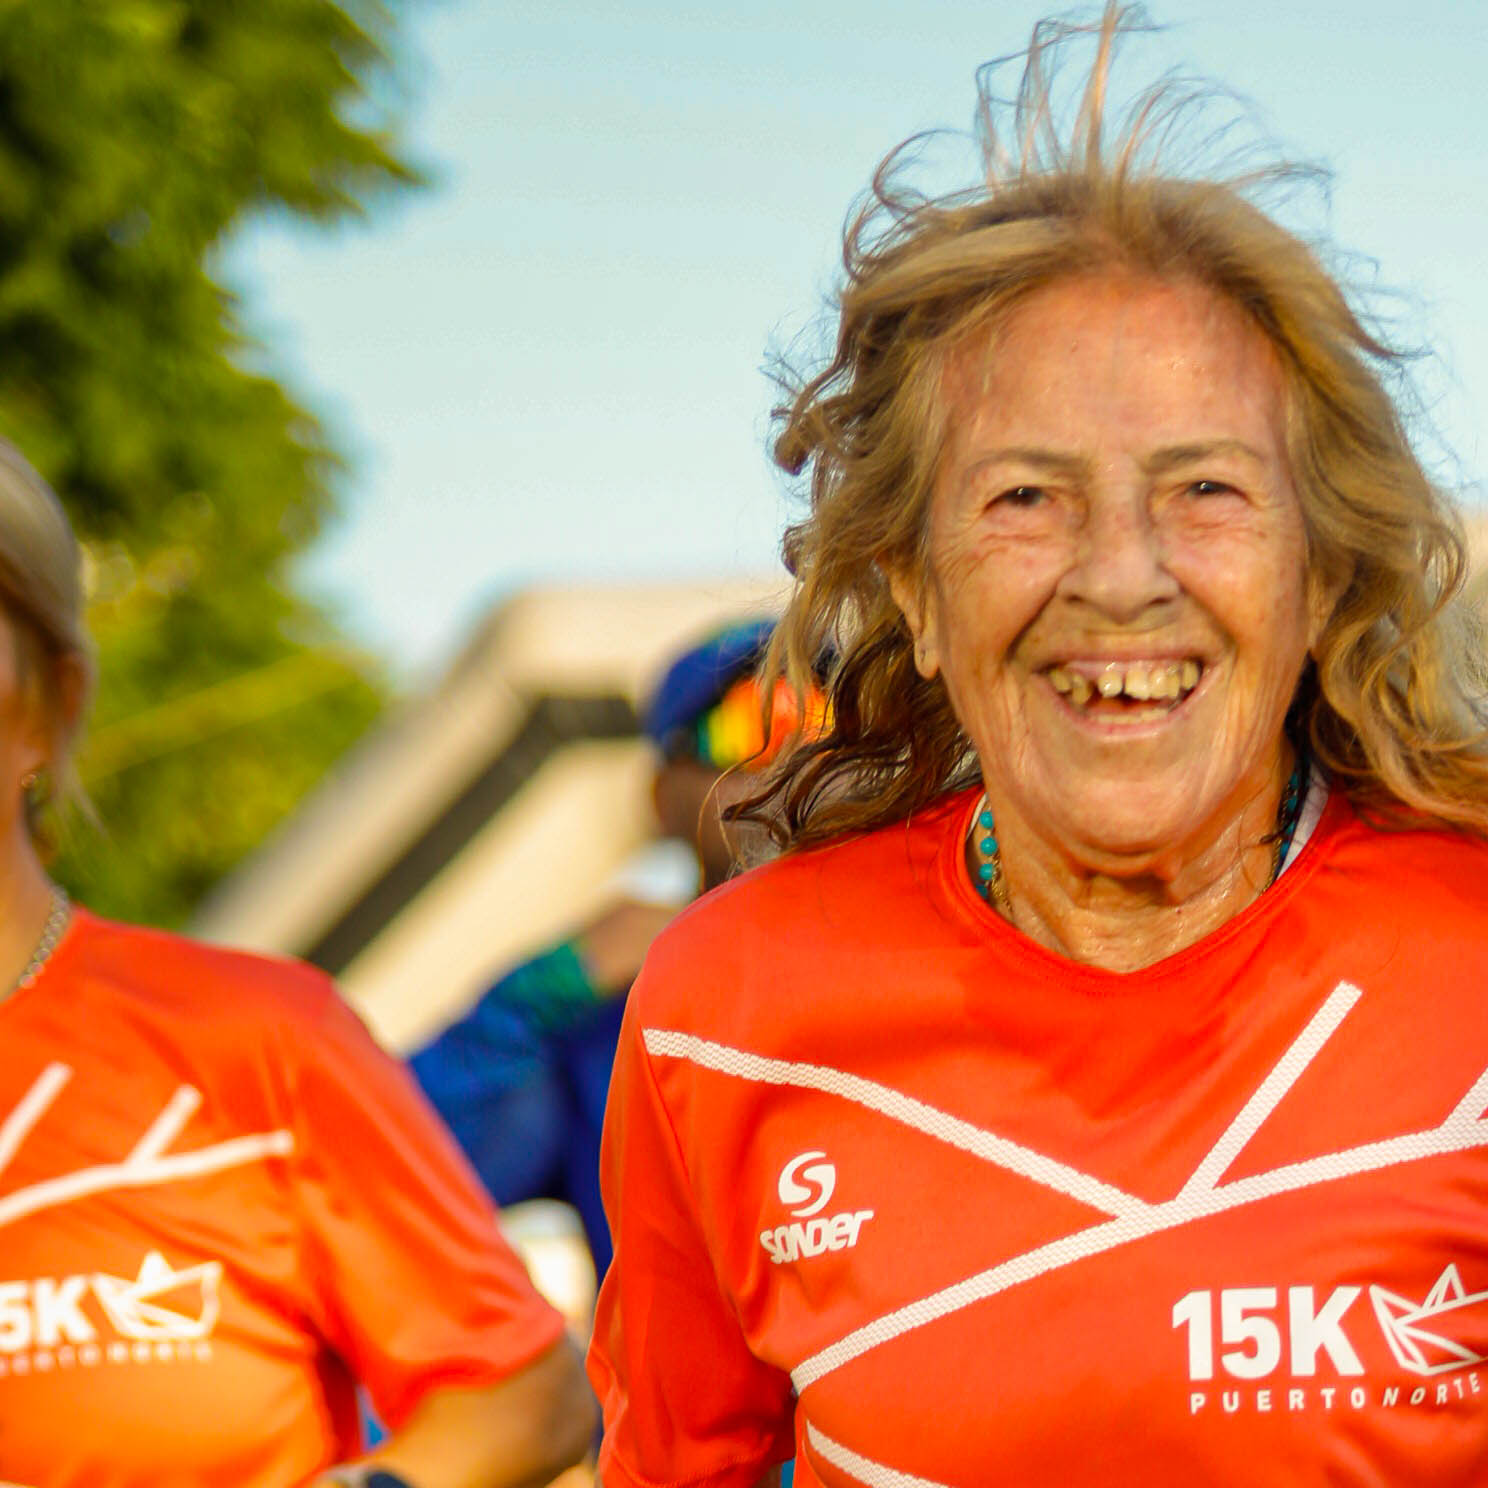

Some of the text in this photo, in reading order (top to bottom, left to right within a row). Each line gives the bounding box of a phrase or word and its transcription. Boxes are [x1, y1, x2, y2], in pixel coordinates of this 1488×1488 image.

[1172, 1286, 1365, 1381] 15K
[1190, 1373, 1481, 1415] PUERTO NORTE
